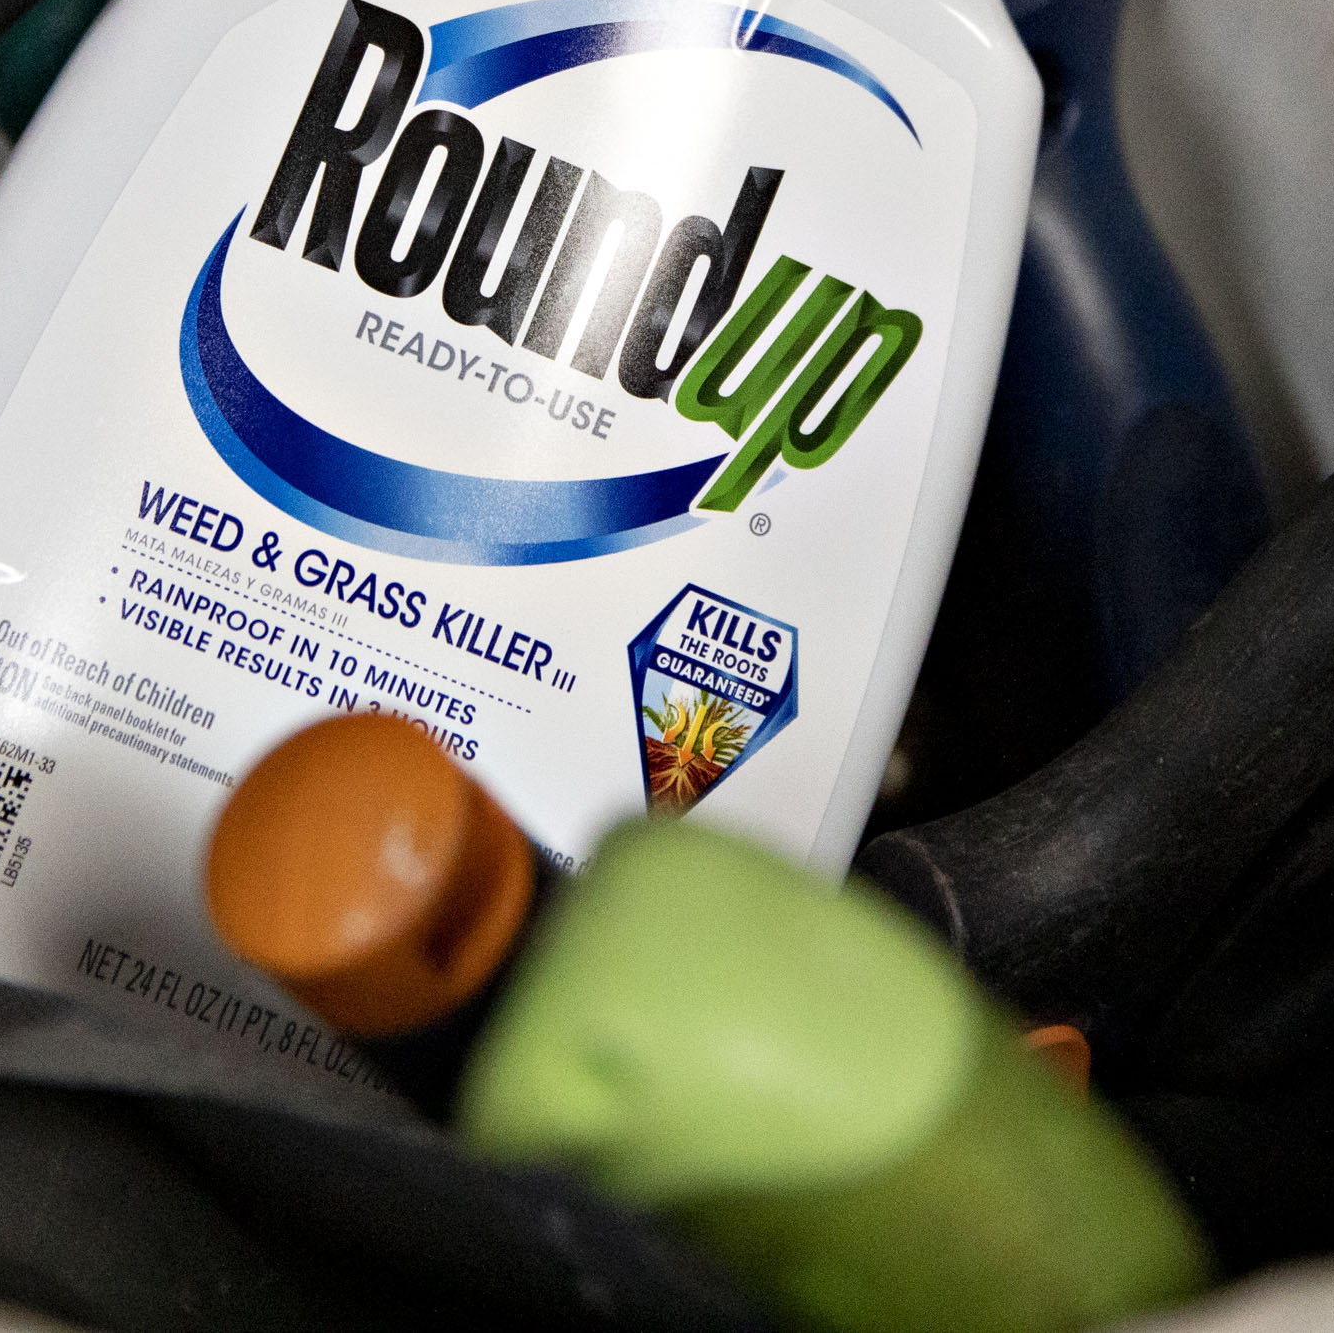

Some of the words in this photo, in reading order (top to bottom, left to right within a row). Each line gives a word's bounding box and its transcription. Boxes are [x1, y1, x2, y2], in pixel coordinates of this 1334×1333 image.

[356, 310, 616, 441] READY-TO-USE
[125, 528, 165, 554] MATA
[171, 547, 242, 584] MALEZAS
[247, 577, 257, 590] Y
[260, 584, 328, 620] GRAMAS
[136, 481, 244, 552] WEED
[252, 531, 283, 572] &
[294, 549, 427, 629] GRASS
[431, 603, 553, 682] KILLER
[120, 598, 212, 652] VISIBLE
[218, 643, 322, 698] RESULTS
[328, 685, 359, 713] IN
[129, 569, 285, 646] RAINPROOF
[290, 634, 320, 662] IN
[328, 649, 358, 677] 10
[363, 664, 477, 726] MINUTES
[679, 634, 710, 658] THE
[712, 648, 769, 682] ROOTS
[686, 599, 782, 663] KILLS
[30, 637, 53, 661] of
[51, 641, 109, 687] Reach
[112, 672, 137, 695] of
[135, 678, 216, 730] Children
[35, 696, 91, 728] additional
[89, 719, 168, 764] precautionary
[66, 685, 96, 709] back
[91, 700, 126, 723] panel
[125, 710, 168, 740] booklet
[168, 728, 187, 747] for
[76, 938, 130, 986] NET
[125, 961, 156, 996] 24
[153, 970, 182, 1010] FL
[185, 982, 221, 1024] OZ
[278, 1020, 297, 1054] 8
[295, 1030, 323, 1066] FL
